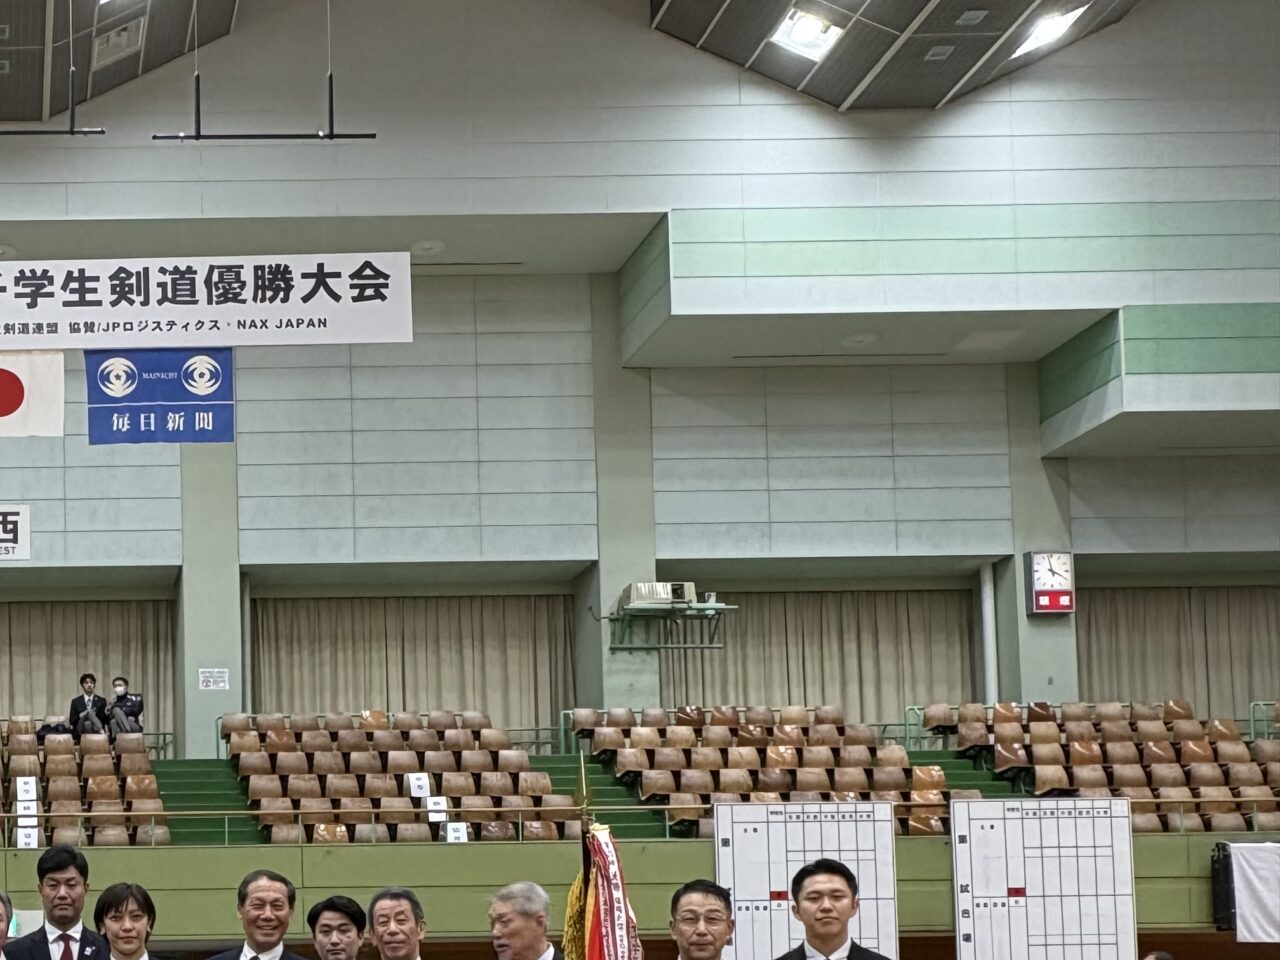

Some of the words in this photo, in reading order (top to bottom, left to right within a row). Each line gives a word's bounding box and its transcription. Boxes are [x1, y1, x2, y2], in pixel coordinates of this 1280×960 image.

[275, 317, 328, 329] JAPAN
[112, 411, 214, 432] 毎日新聞
